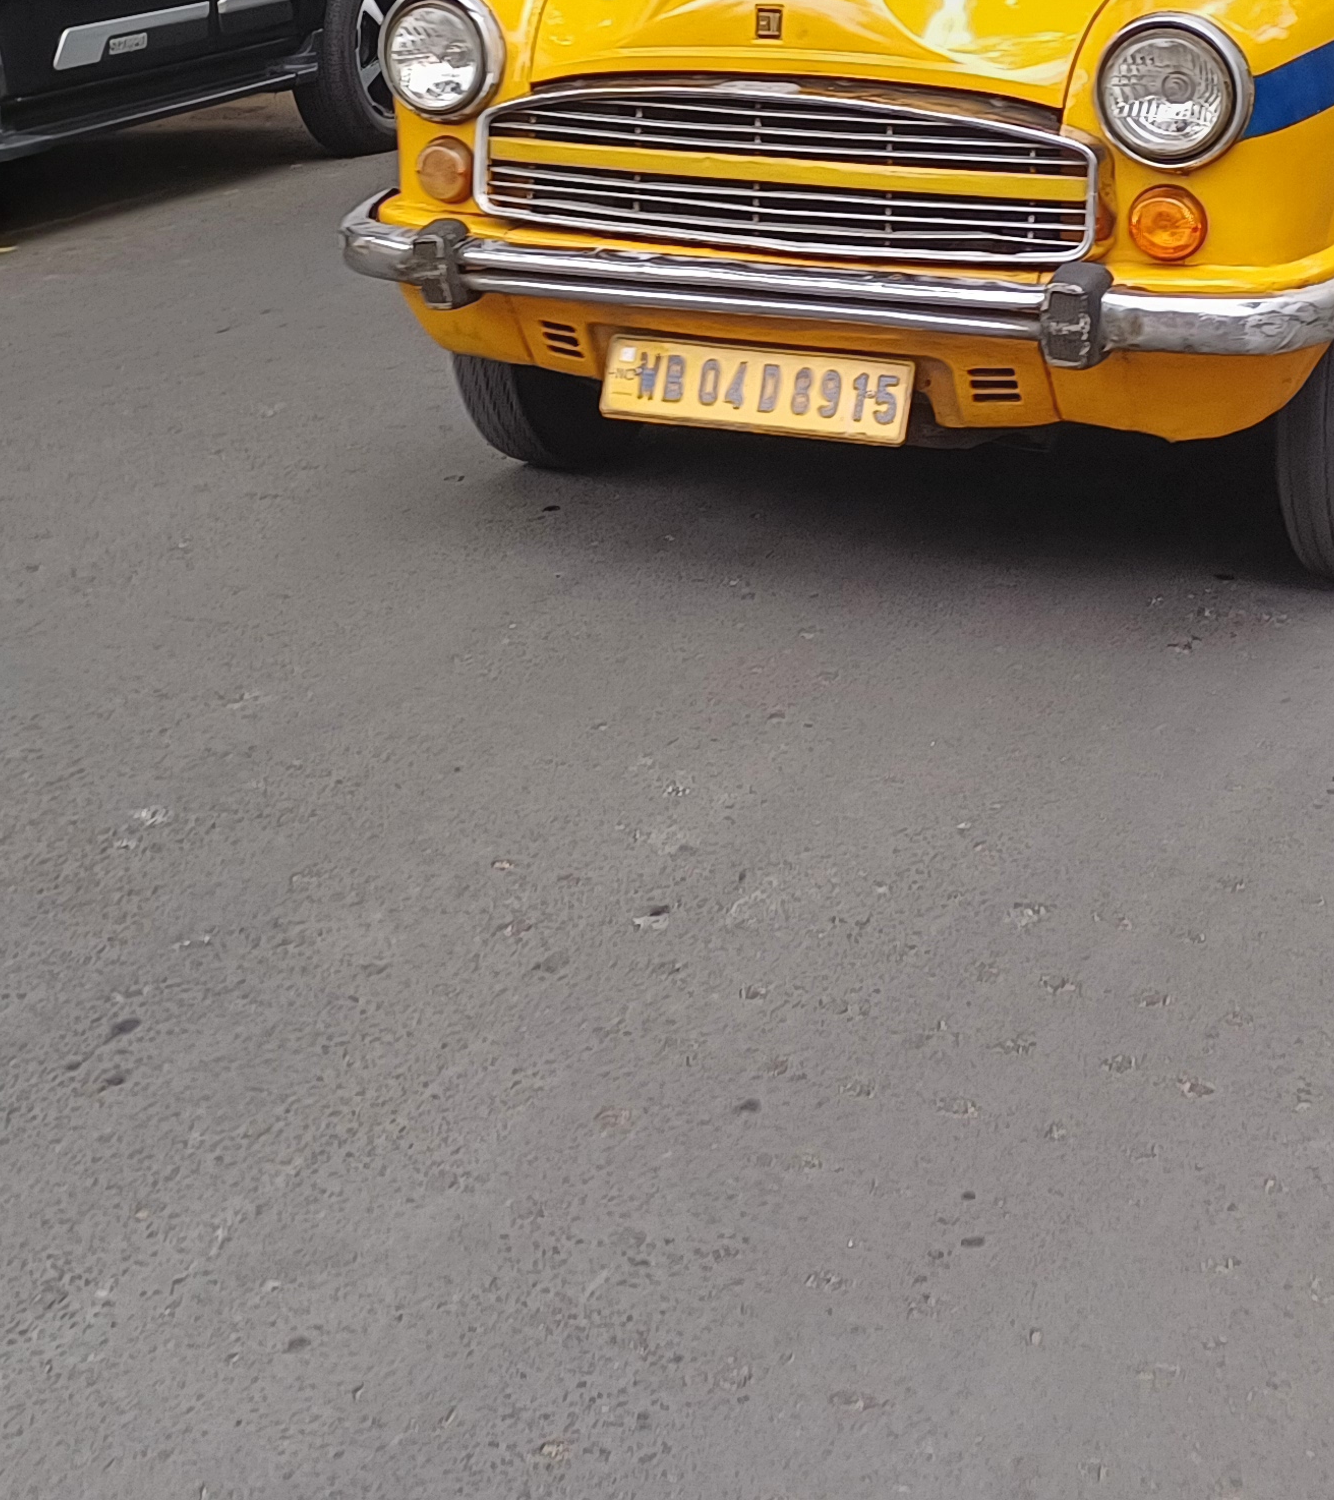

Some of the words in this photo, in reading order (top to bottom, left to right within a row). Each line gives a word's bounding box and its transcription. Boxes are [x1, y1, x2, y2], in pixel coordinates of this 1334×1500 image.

[637, 352, 686, 402] WB
[698, 358, 748, 410] 04
[791, 367, 900, 425] 8915
